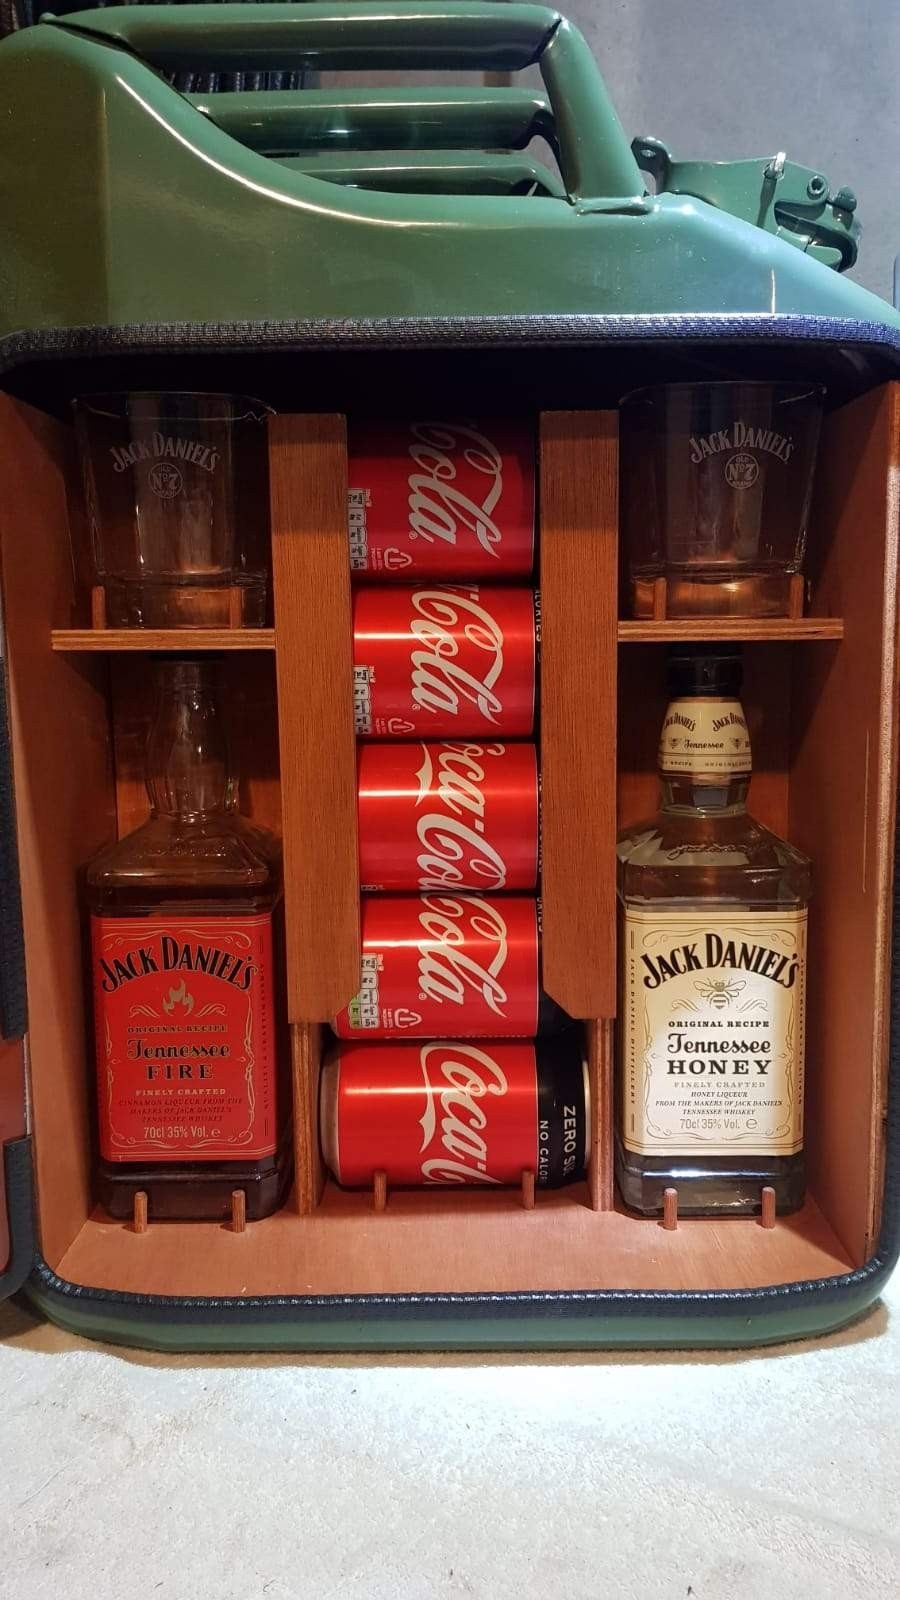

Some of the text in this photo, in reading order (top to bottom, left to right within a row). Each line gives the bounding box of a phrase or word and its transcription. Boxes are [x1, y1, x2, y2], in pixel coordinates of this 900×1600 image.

[690, 421, 794, 464] JACK DANIEL'S
[109, 431, 220, 474] JACK DANIEL'S
[684, 739, 725, 749] Tennessee
[100, 935, 259, 993] JACK DANIEL'S
[640, 933, 801, 989] JACK DANIEL'S
[127, 1023, 228, 1033] ORIGINAL RECIPE
[668, 1020, 770, 1028] ORIGINAL RECIPE
[127, 1039, 230, 1060] Tennessee
[667, 1032, 772, 1054] Tennessee
[147, 1063, 214, 1080] FIRE
[666, 1059, 773, 1075] HONEY
[177, 1088, 227, 1096] CRAFTED
[716, 1091, 749, 1099] LIQUEUR
[734, 1100, 752, 1108] JACK
[539, 1119, 549, 1142] NO
[563, 1104, 577, 1154] ZERO
[680, 1118, 700, 1129] 70cl
[701, 1118, 722, 1129] 35%
[723, 1118, 740, 1129] Vol.
[143, 1126, 165, 1139] 70cl
[167, 1125, 189, 1138] 35%
[191, 1125, 209, 1138] Vol.
